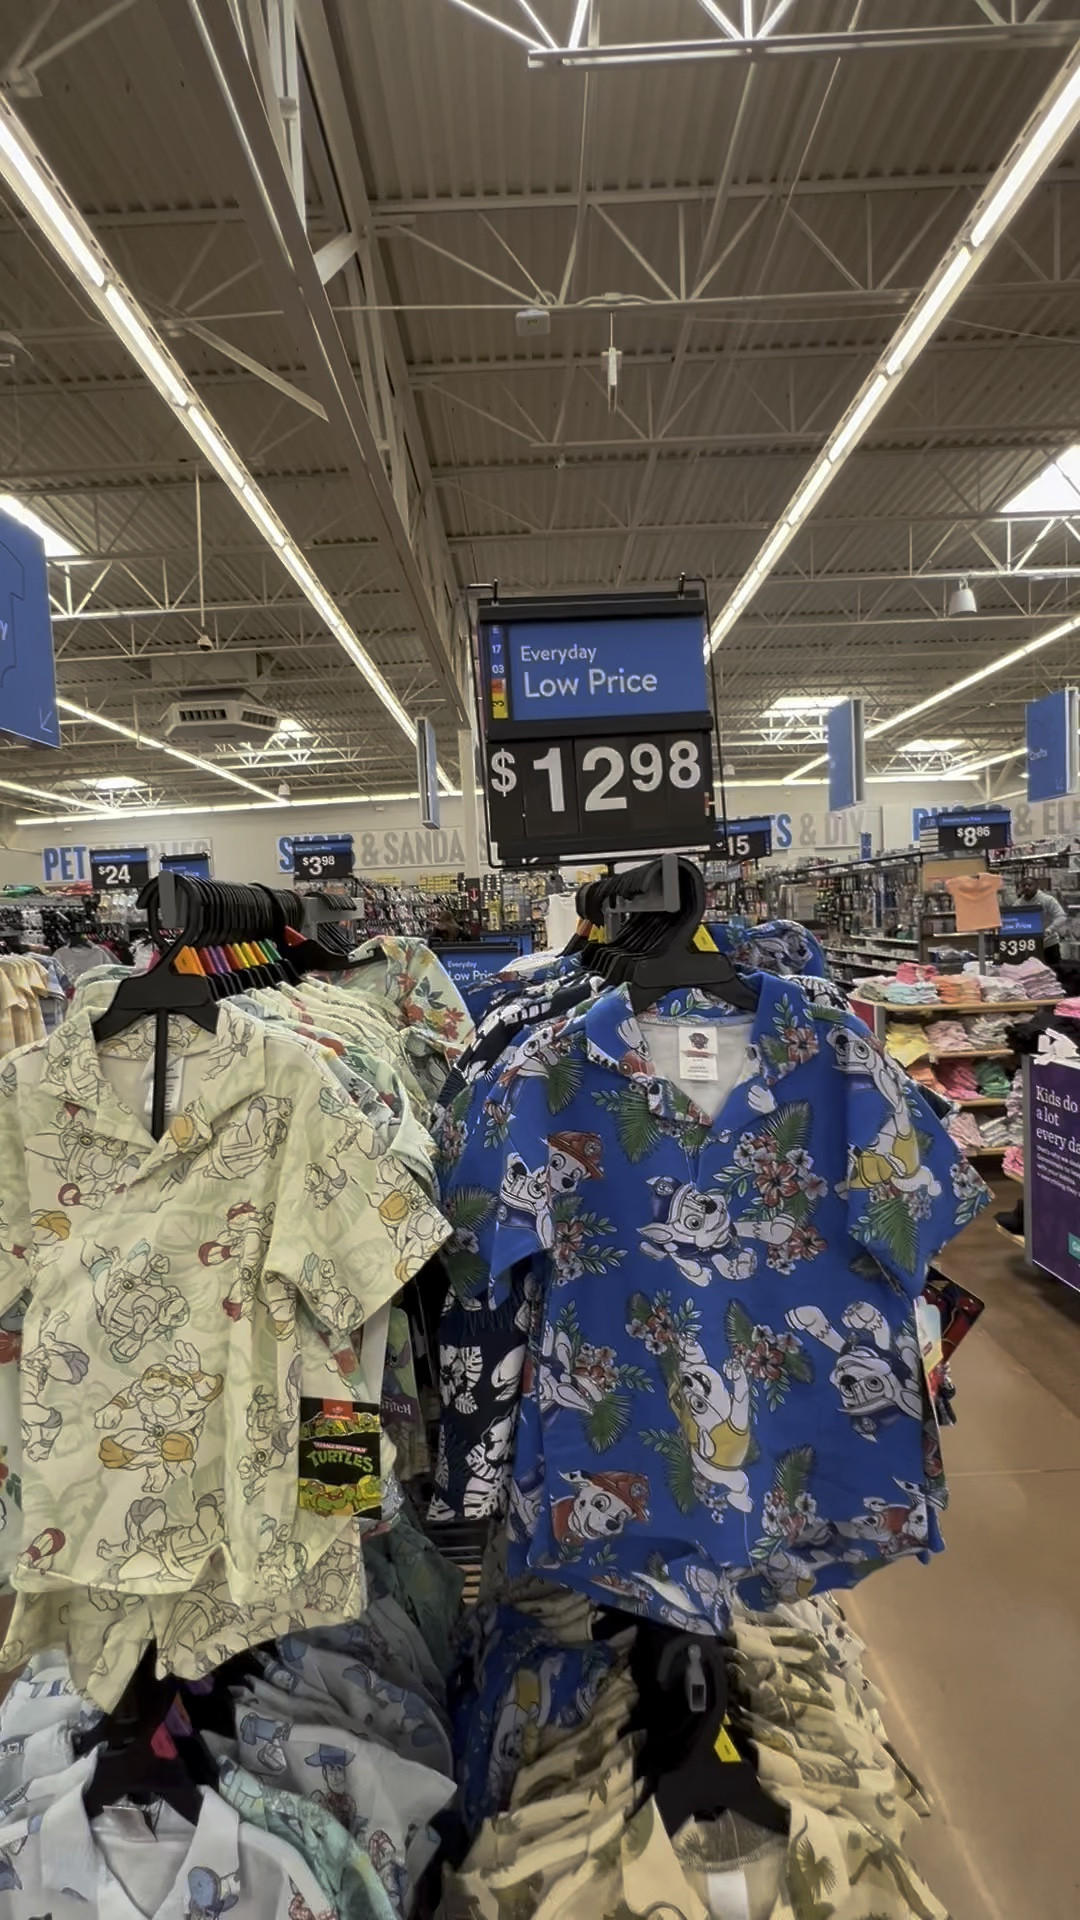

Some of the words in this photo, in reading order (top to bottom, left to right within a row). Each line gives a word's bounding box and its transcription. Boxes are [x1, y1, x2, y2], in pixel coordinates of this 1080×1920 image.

[491, 644, 502, 654] 17
[520, 644, 597, 665] Everyday
[491, 664, 505, 674] 03
[523, 670, 579, 698] Low
[588, 668, 658, 695] Price
[799, 813, 817, 846] &
[825, 810, 865, 846] DIY
[1013, 803, 1033, 836] &
[361, 832, 380, 866] &
[383, 830, 487, 865] SANDA
[727, 835, 750, 857] 15
[43, 846, 87, 881] PET
[98, 864, 132, 885] $24
[447, 961, 478, 969] Everyday
[448, 971, 470, 981] Low
[1036, 1084, 1062, 1108] Kids
[1063, 1094, 1079, 1113] do
[1036, 1108, 1043, 1120] a
[1044, 1106, 1060, 1127] lot
[1036, 1127, 1067, 1151] every
[306, 1449, 374, 1474] TURTLES
